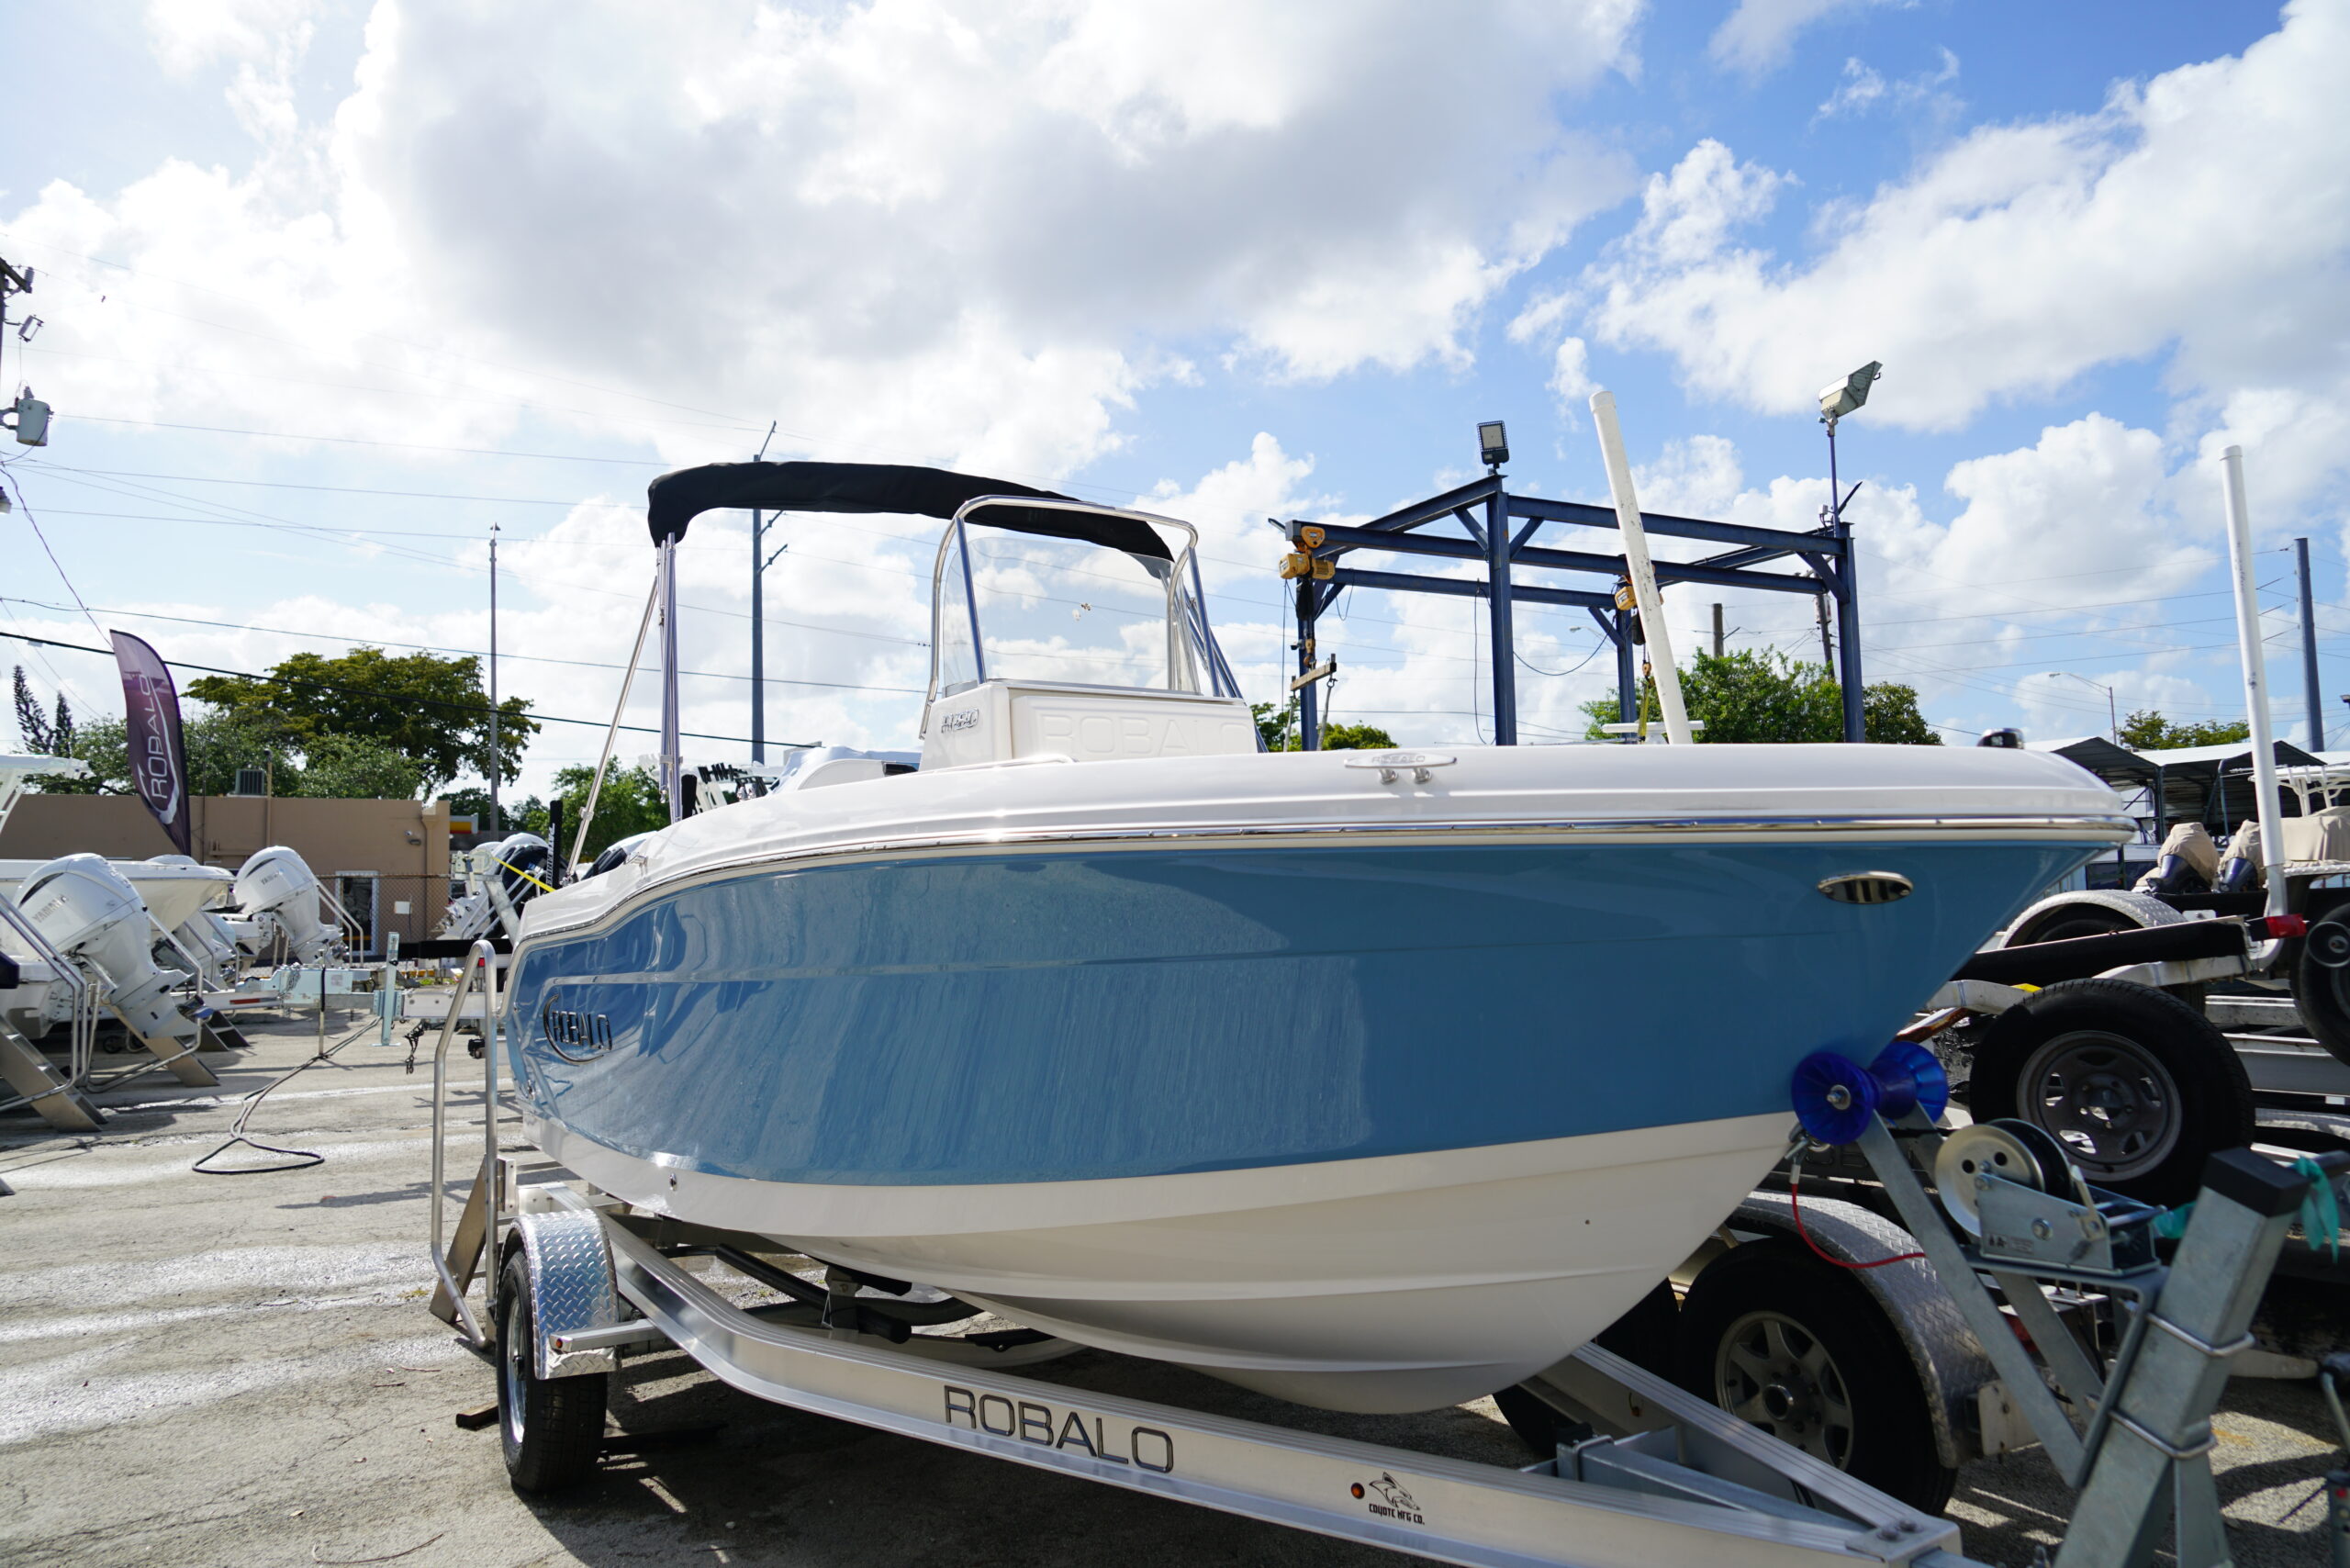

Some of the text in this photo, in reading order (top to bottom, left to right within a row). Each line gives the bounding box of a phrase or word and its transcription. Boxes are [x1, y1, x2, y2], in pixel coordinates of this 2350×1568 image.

[139, 674, 169, 800] ROBALO
[1039, 713, 1251, 756] ROBALO
[552, 1010, 613, 1051] ROBALO
[944, 1384, 1174, 1473] ROBALO
[1369, 1503, 1396, 1518] COYOTE
[1397, 1509, 1412, 1522] MFG
